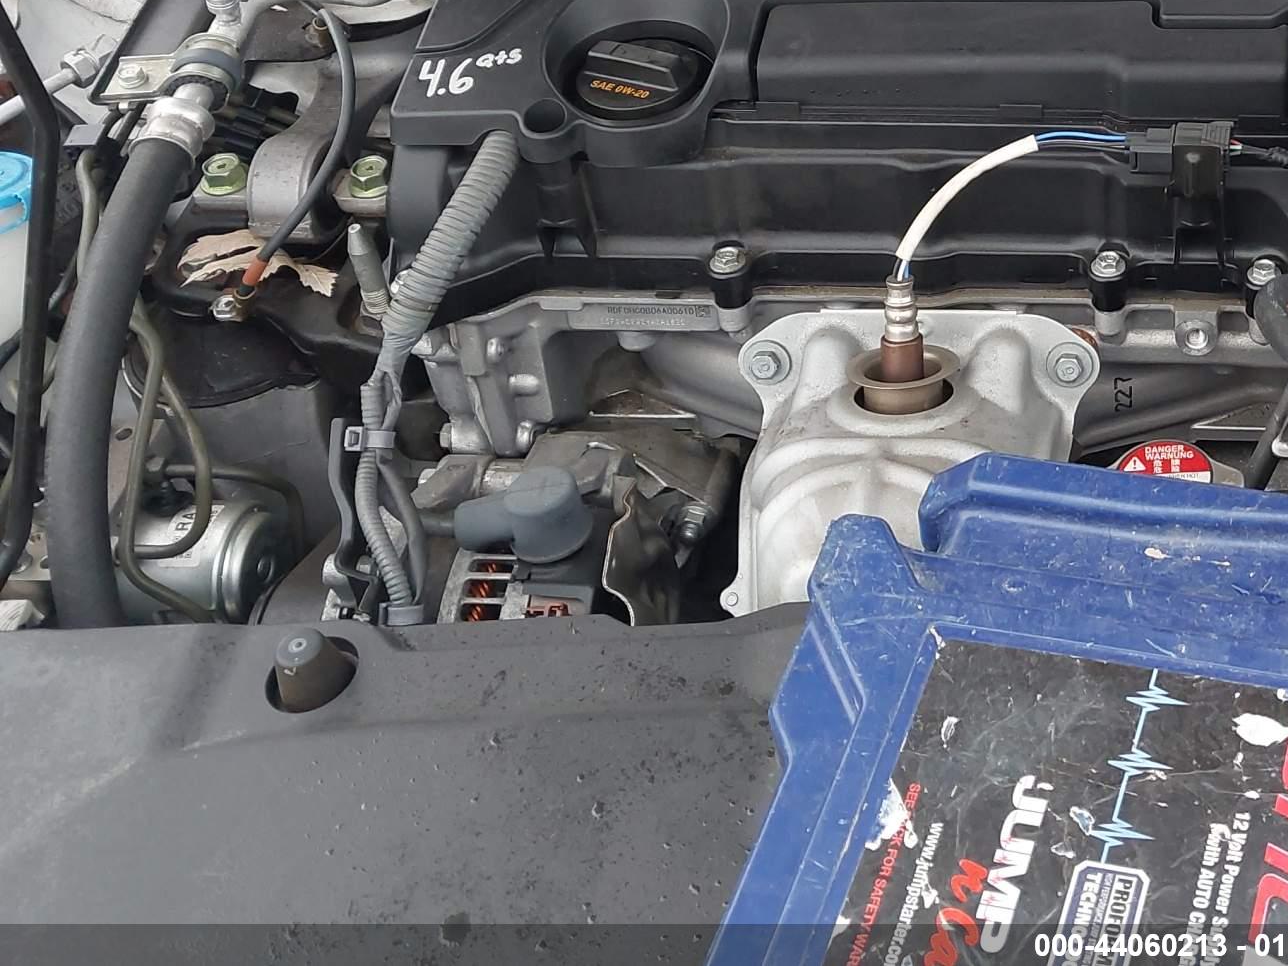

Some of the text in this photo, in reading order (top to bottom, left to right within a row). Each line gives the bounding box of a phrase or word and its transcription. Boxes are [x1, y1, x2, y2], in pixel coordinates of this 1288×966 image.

[418, 58, 475, 98] 4.6
[590, 79, 650, 99] SAE 0W-20
[1145, 445, 1184, 453] DANGER
[1145, 451, 1194, 460] WARNUNG
[903, 782, 921, 811] SEE
[1232, 811, 1250, 832] 12
[878, 848, 899, 878] FOR
[1225, 833, 1248, 863] Volt
[976, 775, 1049, 954] JUMP
[1193, 867, 1215, 909] AUTO
[1215, 864, 1240, 914] Power
[861, 878, 888, 933] SAFETY
